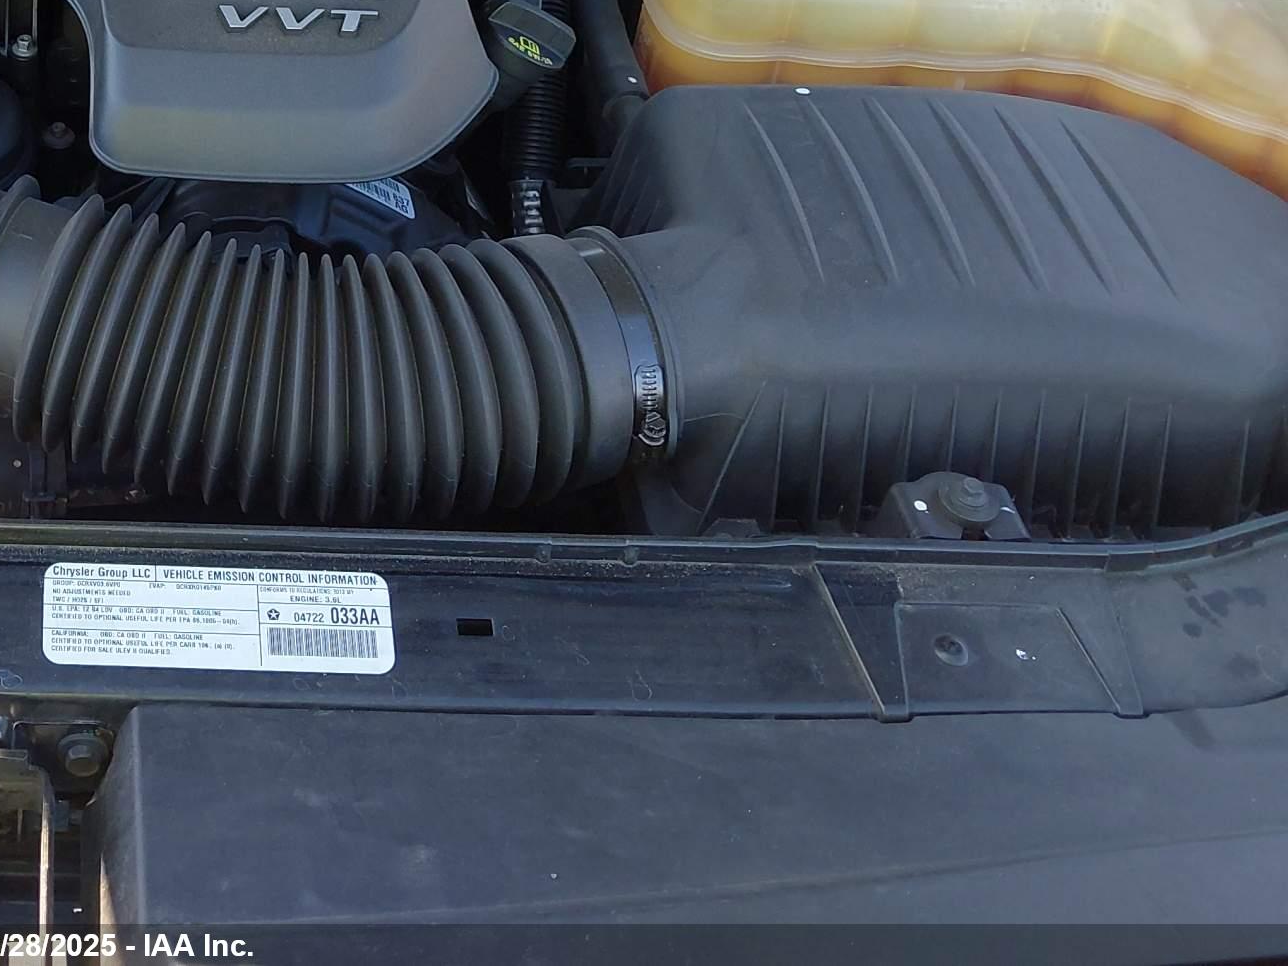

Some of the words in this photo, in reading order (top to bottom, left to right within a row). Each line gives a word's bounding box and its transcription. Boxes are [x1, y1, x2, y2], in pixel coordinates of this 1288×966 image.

[219, 4, 380, 33] VVT
[53, 565, 95, 578] Chrysler
[98, 567, 128, 579] Group
[132, 568, 151, 579] LLC
[163, 569, 204, 580] VEHICLE
[207, 571, 255, 582] EMISSION
[258, 572, 305, 583] CONTROL
[308, 574, 377, 586] INFORMATION
[294, 612, 325, 624] 04722
[331, 607, 380, 625] 033AA
